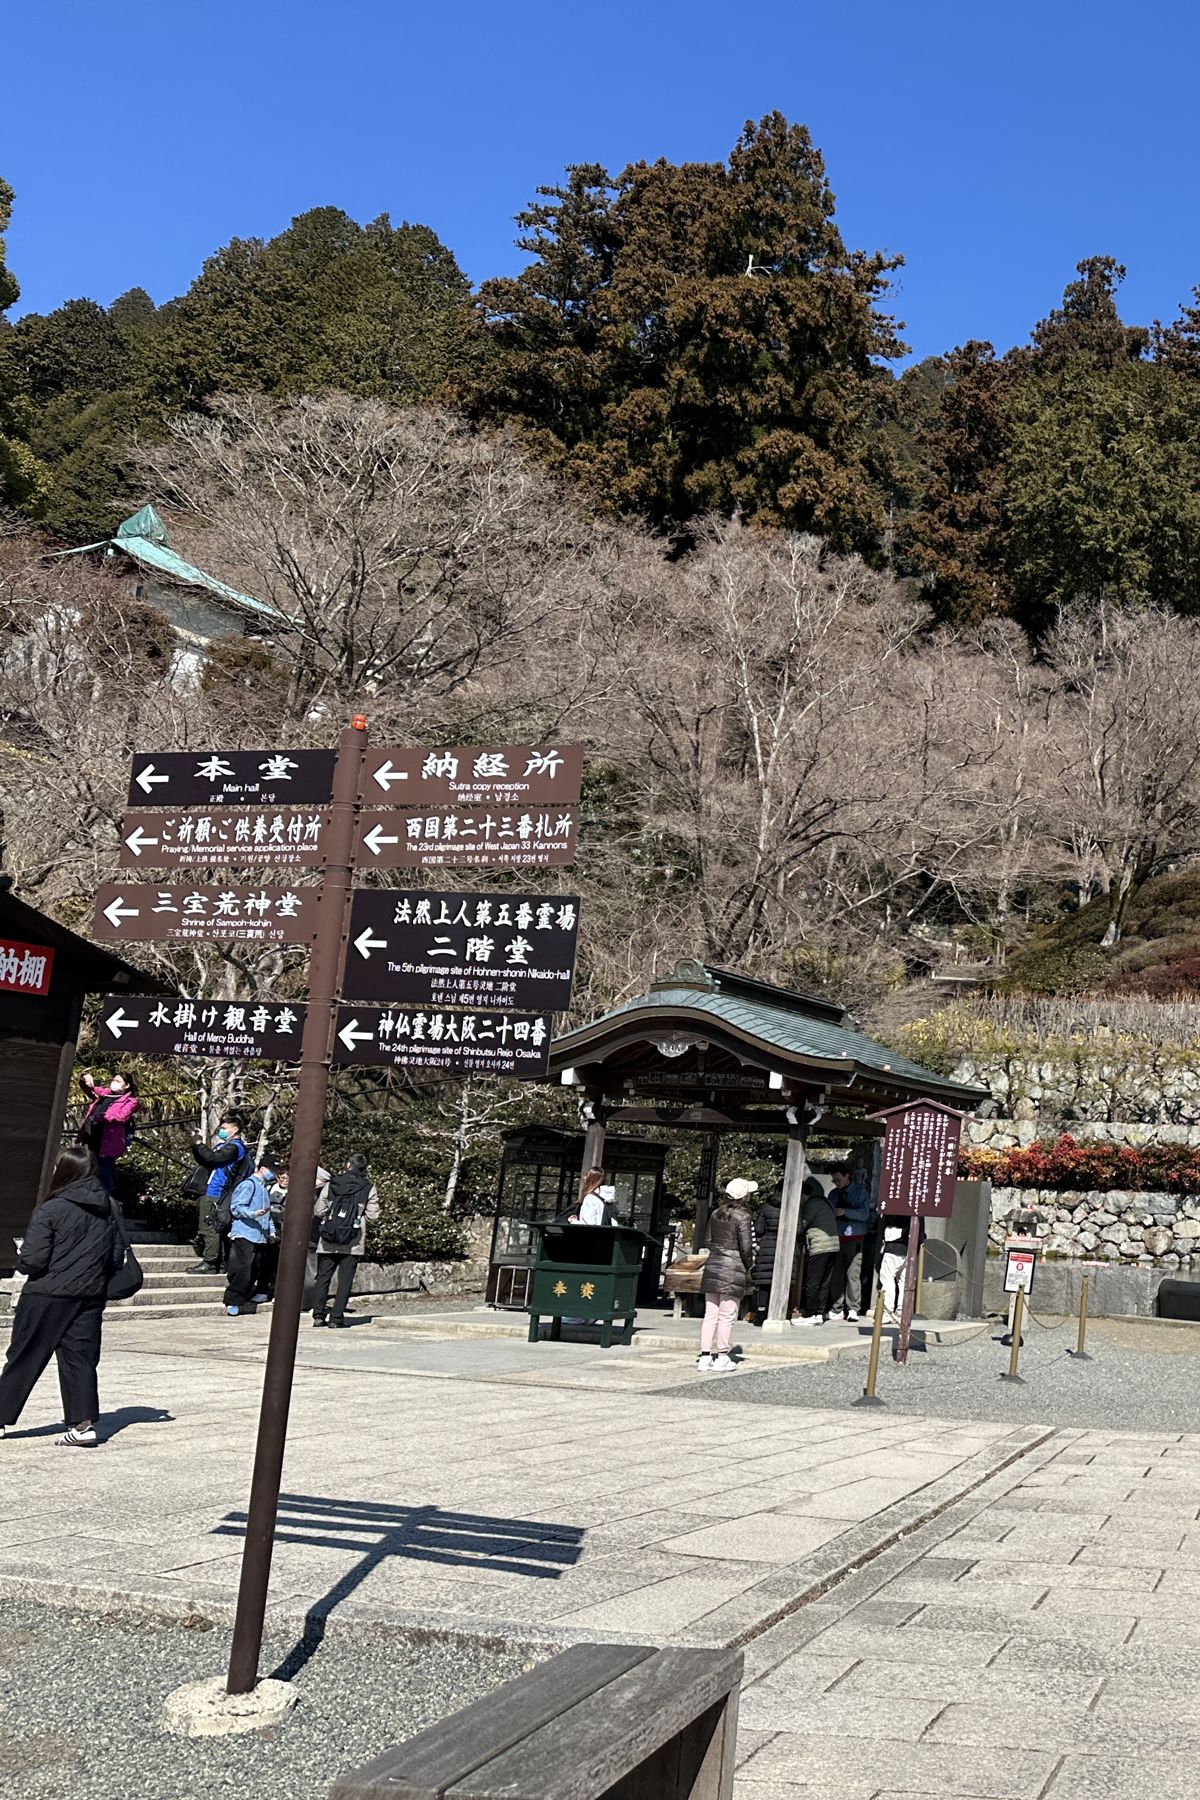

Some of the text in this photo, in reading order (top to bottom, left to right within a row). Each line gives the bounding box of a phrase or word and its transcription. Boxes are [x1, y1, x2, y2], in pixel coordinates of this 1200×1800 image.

[194, 754, 299, 782] 本堂
[421, 750, 565, 780] 納経所
[222, 783, 260, 793] Main hall
[449, 782, 530, 792] Sutra copy reception
[405, 812, 573, 841] 西国第二十三番札所
[226, 845, 253, 853] service
[253, 844, 295, 854] application
[297, 843, 318, 852] place
[406, 841, 568, 852] The 23rd pilgrimage site of West Japan 33 Kannons
[151, 890, 303, 918] 三宝荒神堂
[393, 898, 576, 931] 法然上人第五番霊場
[181, 917, 206, 927] Shrine
[206, 918, 215, 927] of
[426, 935, 534, 965] 二階堂
[387, 961, 401, 972] The
[401, 962, 414, 973] 5th
[415, 963, 449, 976] pilgrimage
[450, 964, 463, 975] site
[464, 965, 472, 975] of
[148, 1001, 298, 1034] 水掛け観音堂
[377, 1010, 547, 1047] 神仏霊場大阪二十四番
[184, 1031, 254, 1045] Hall of Mercy Buddha
[378, 1042, 541, 1059] The 24th pilgrimage site of Shinbutsu Reijo Osaka
